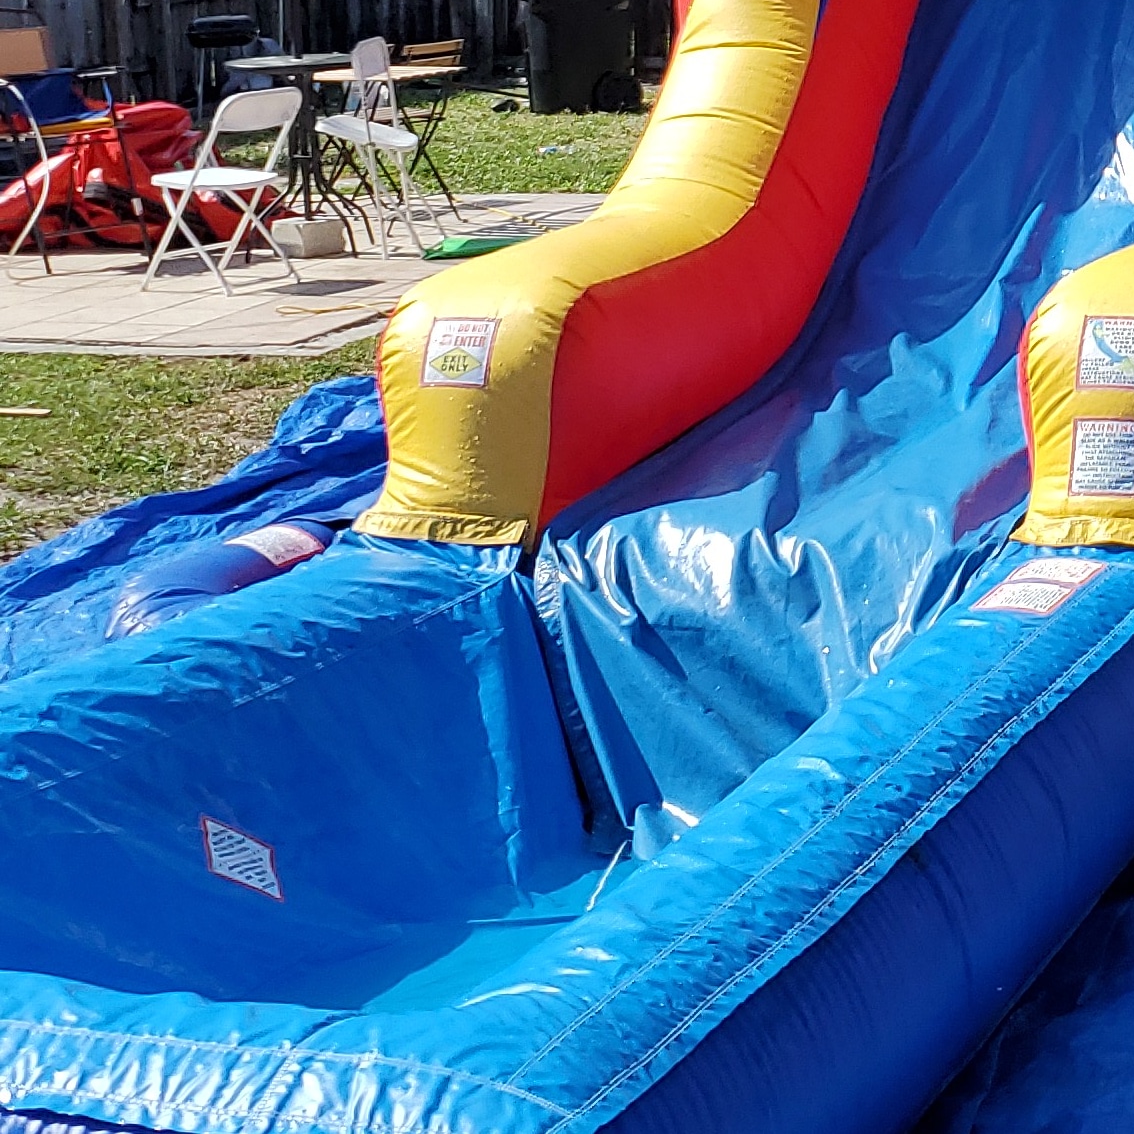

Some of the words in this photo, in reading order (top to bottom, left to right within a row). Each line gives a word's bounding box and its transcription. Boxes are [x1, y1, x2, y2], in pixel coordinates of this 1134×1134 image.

[457, 323, 470, 333] DO
[454, 336, 487, 347] ENTER
[443, 355, 469, 363] EXIT
[441, 363, 469, 372] ONLY
